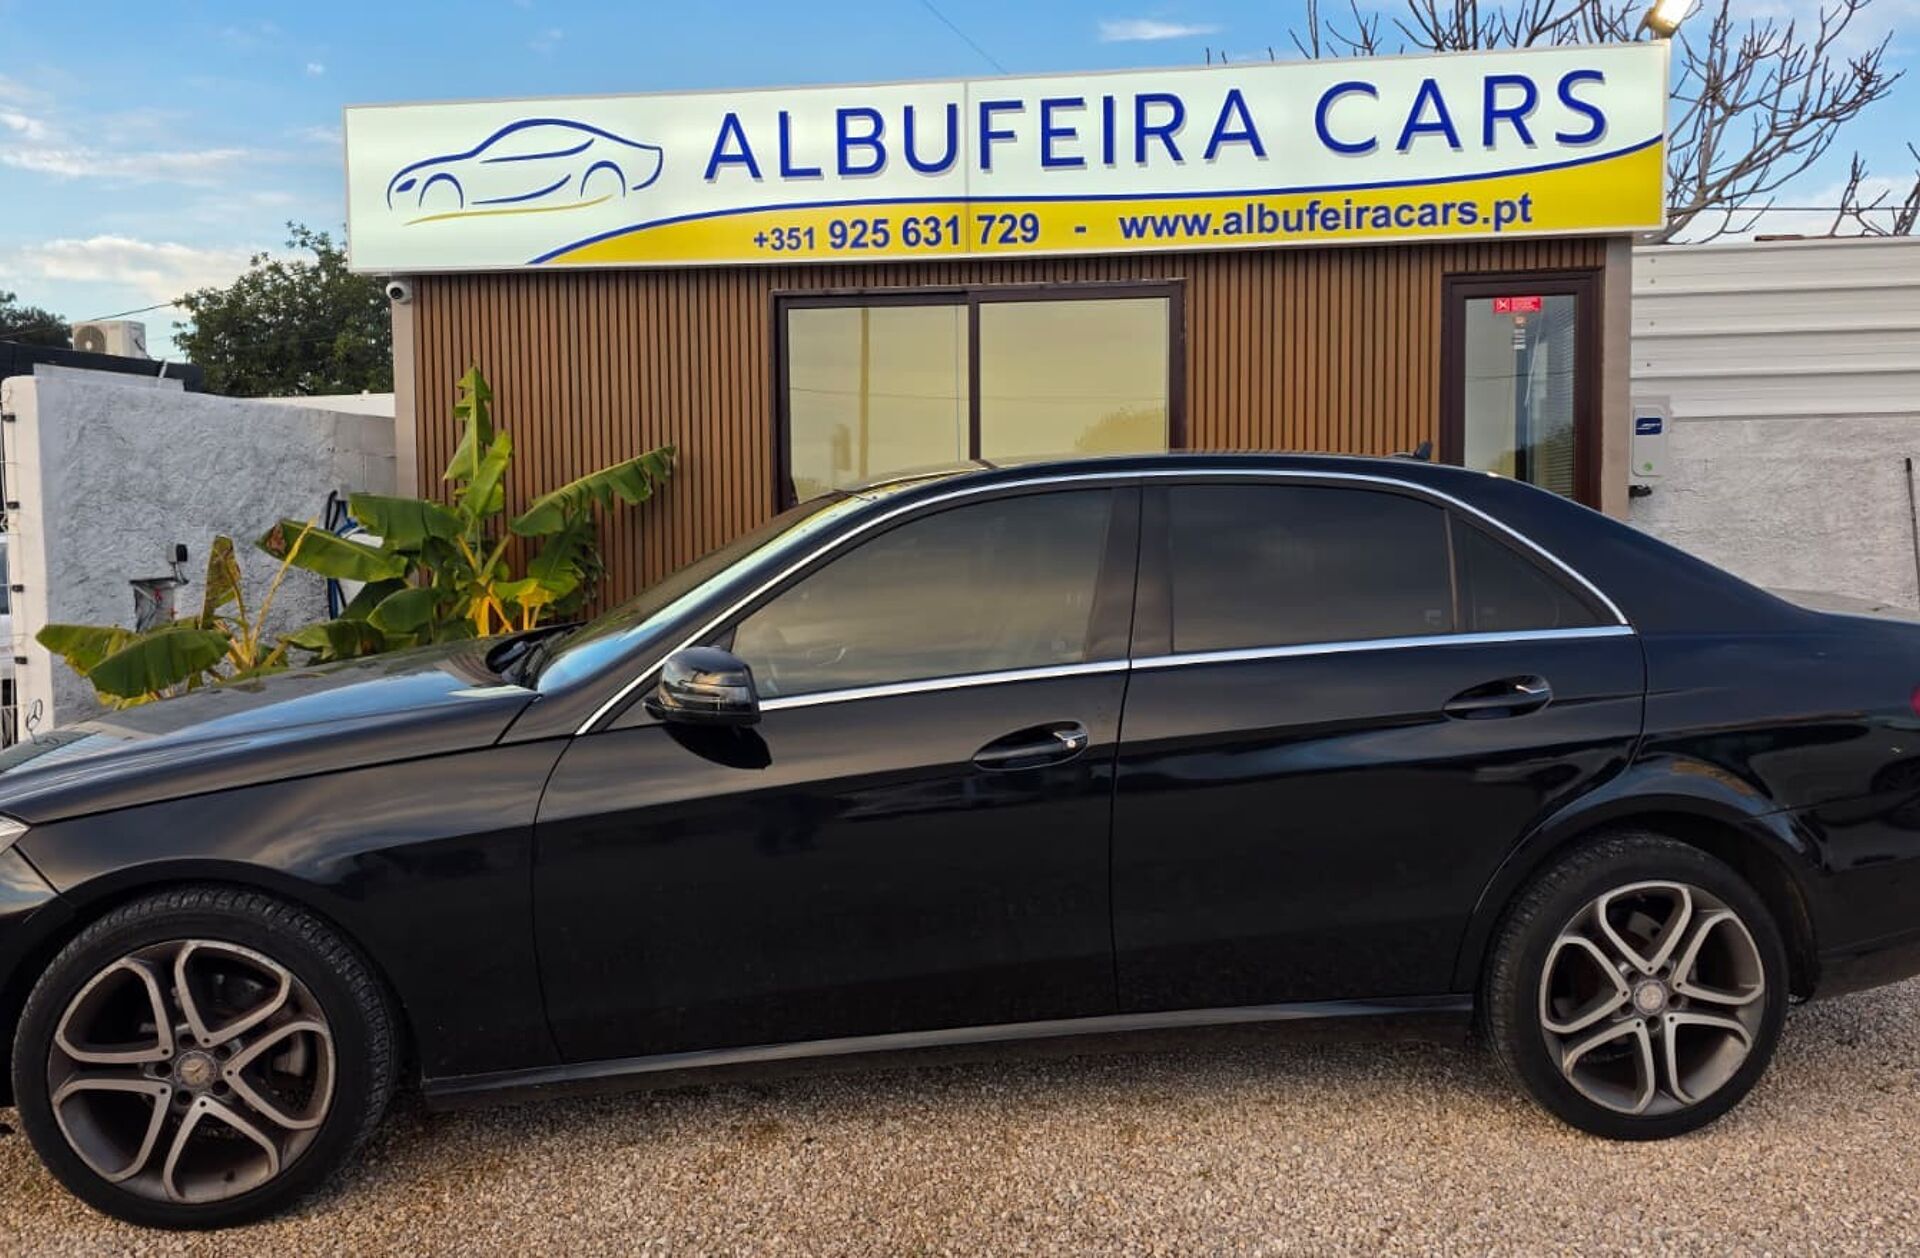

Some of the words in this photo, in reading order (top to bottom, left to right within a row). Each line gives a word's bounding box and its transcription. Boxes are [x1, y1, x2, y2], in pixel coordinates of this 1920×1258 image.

[704, 88, 1268, 181] ALBUFEIRA
[1314, 70, 1607, 154] CARS
[753, 226, 815, 251] +351
[828, 219, 890, 250] 925
[902, 215, 960, 246] 631
[977, 212, 1040, 244] 729
[1119, 193, 1533, 238] www.albufeiracars.pt
